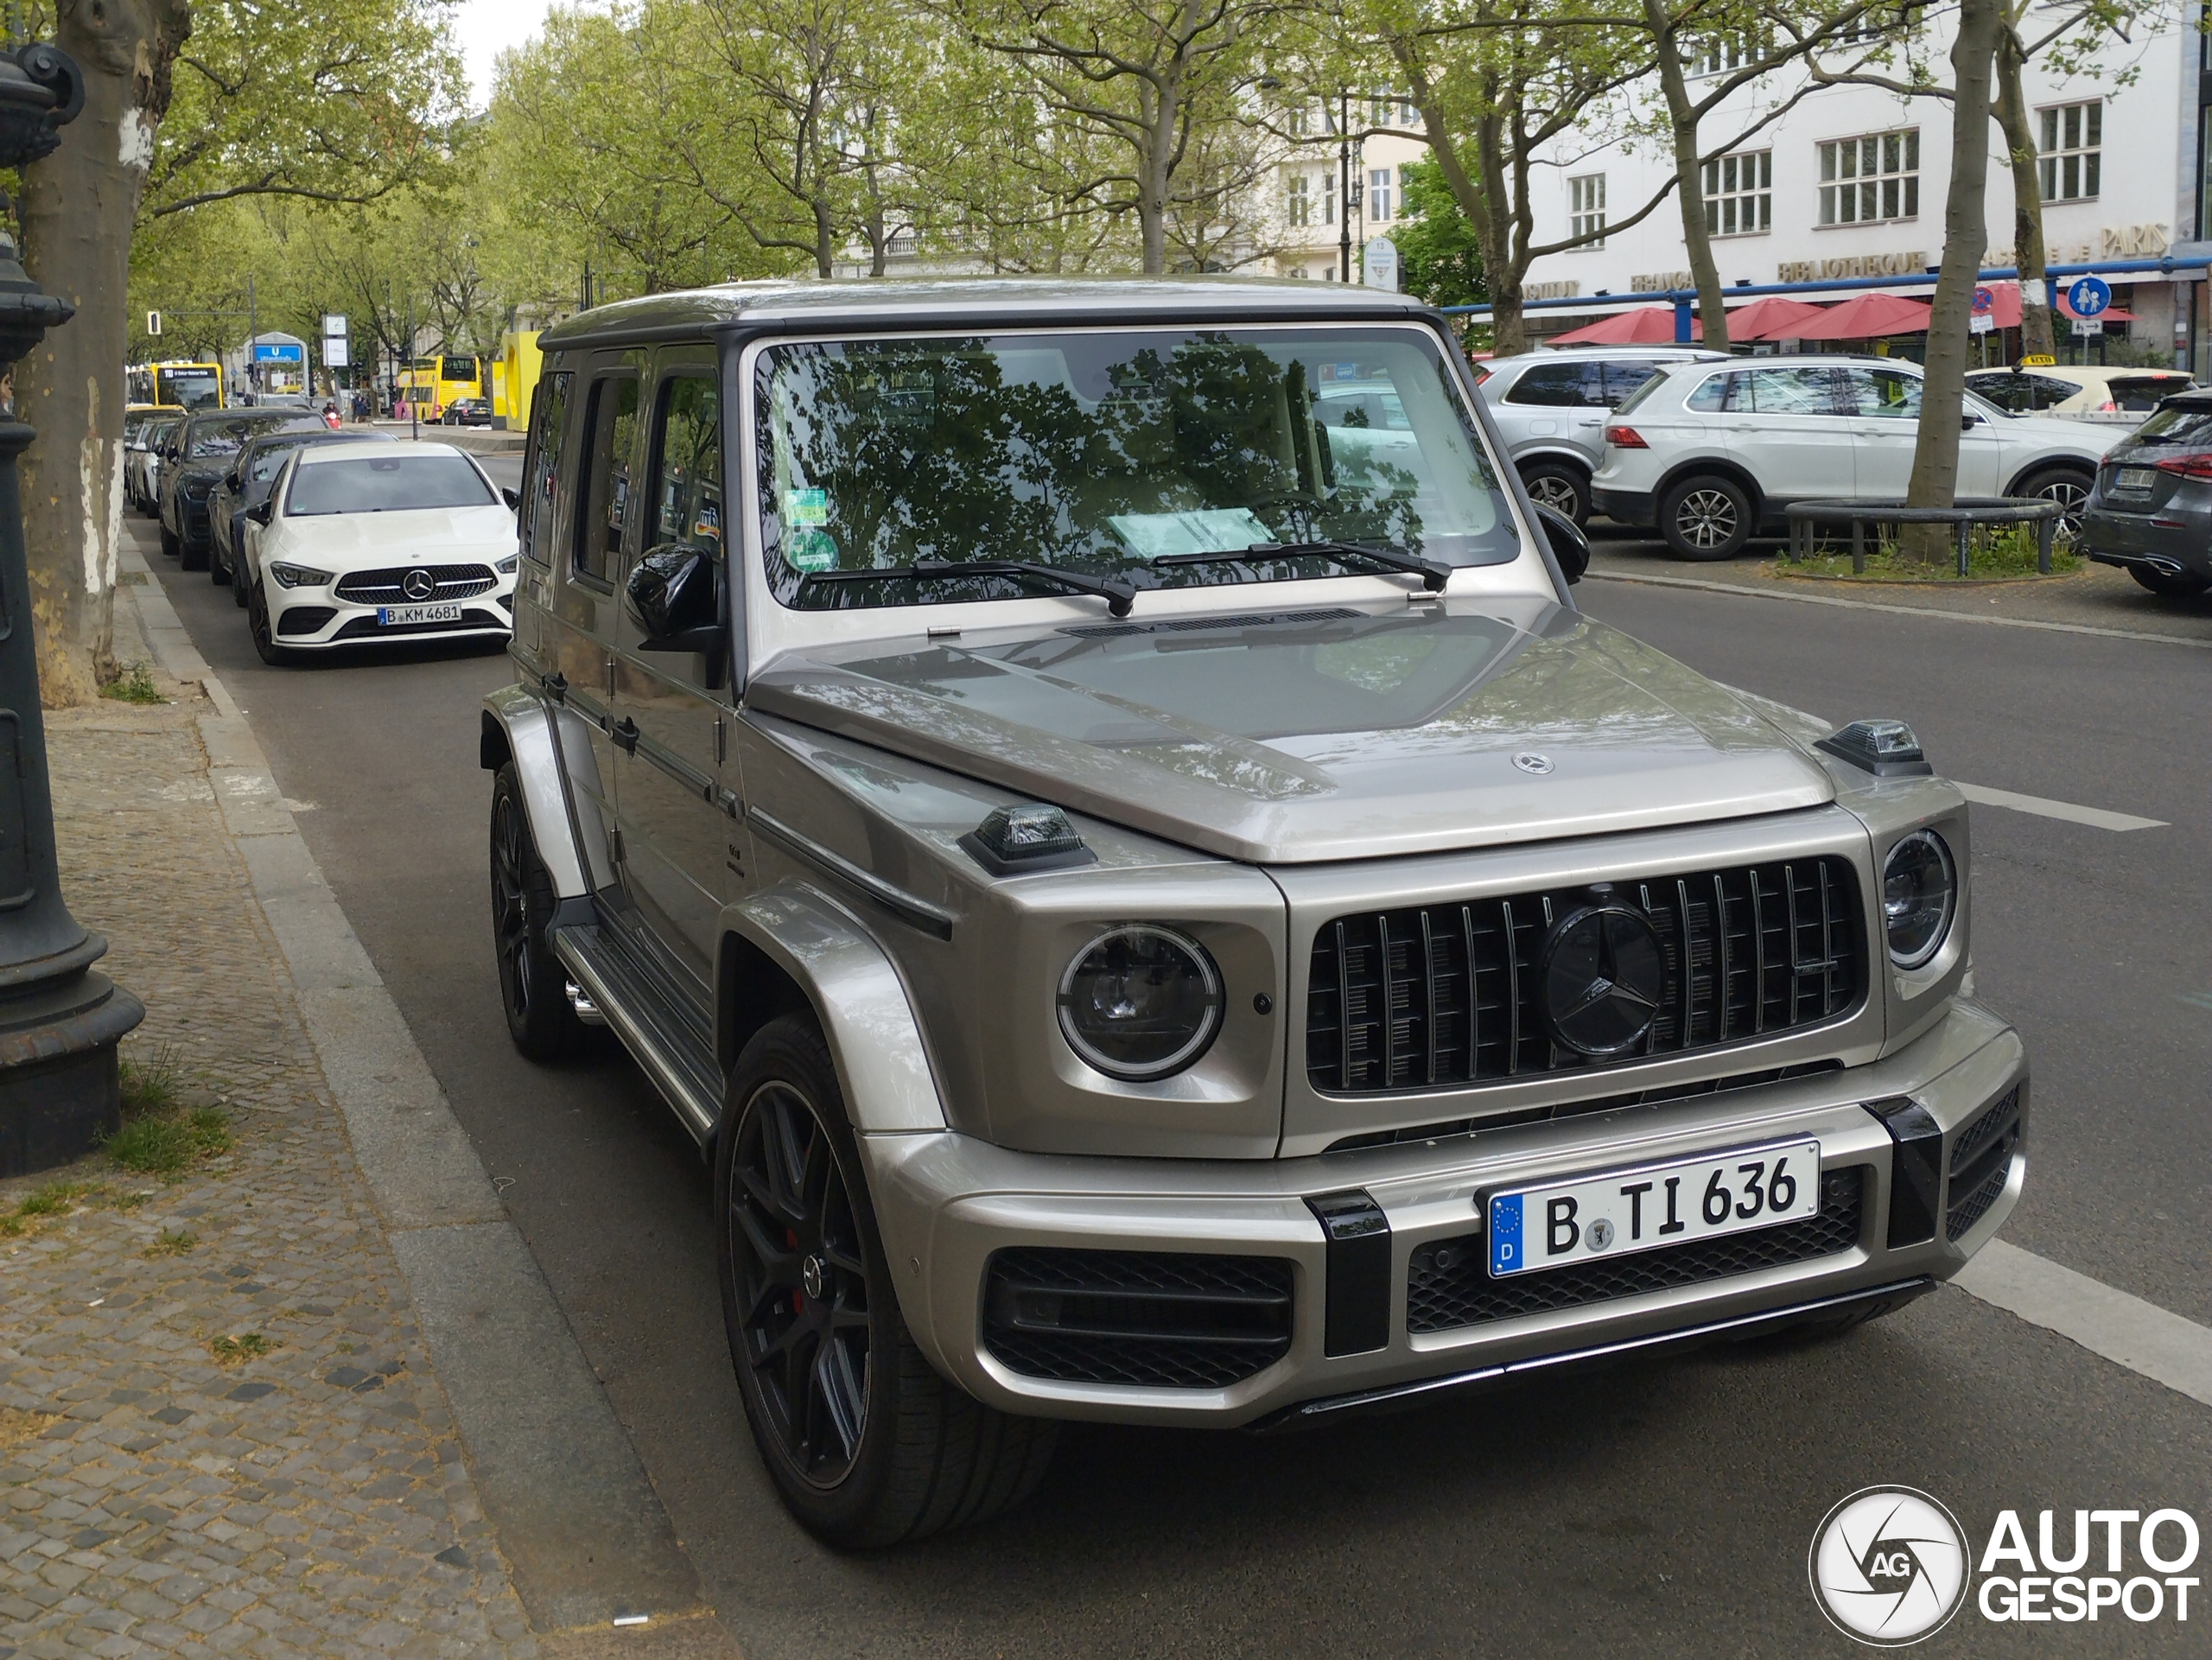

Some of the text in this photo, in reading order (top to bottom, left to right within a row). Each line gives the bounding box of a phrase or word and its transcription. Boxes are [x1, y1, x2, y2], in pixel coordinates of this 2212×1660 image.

[2069, 244, 2091, 261] LE
[2101, 223, 2169, 258] PARIS
[1777, 251, 1927, 283] BIBLIOTHEQUE
[1522, 280, 1580, 300] STITUT
[271, 347, 280, 355] U
[387, 606, 460, 622] B KM 4681
[1547, 1157, 1797, 1256] B TI 636
[1501, 1243, 1514, 1261] D
